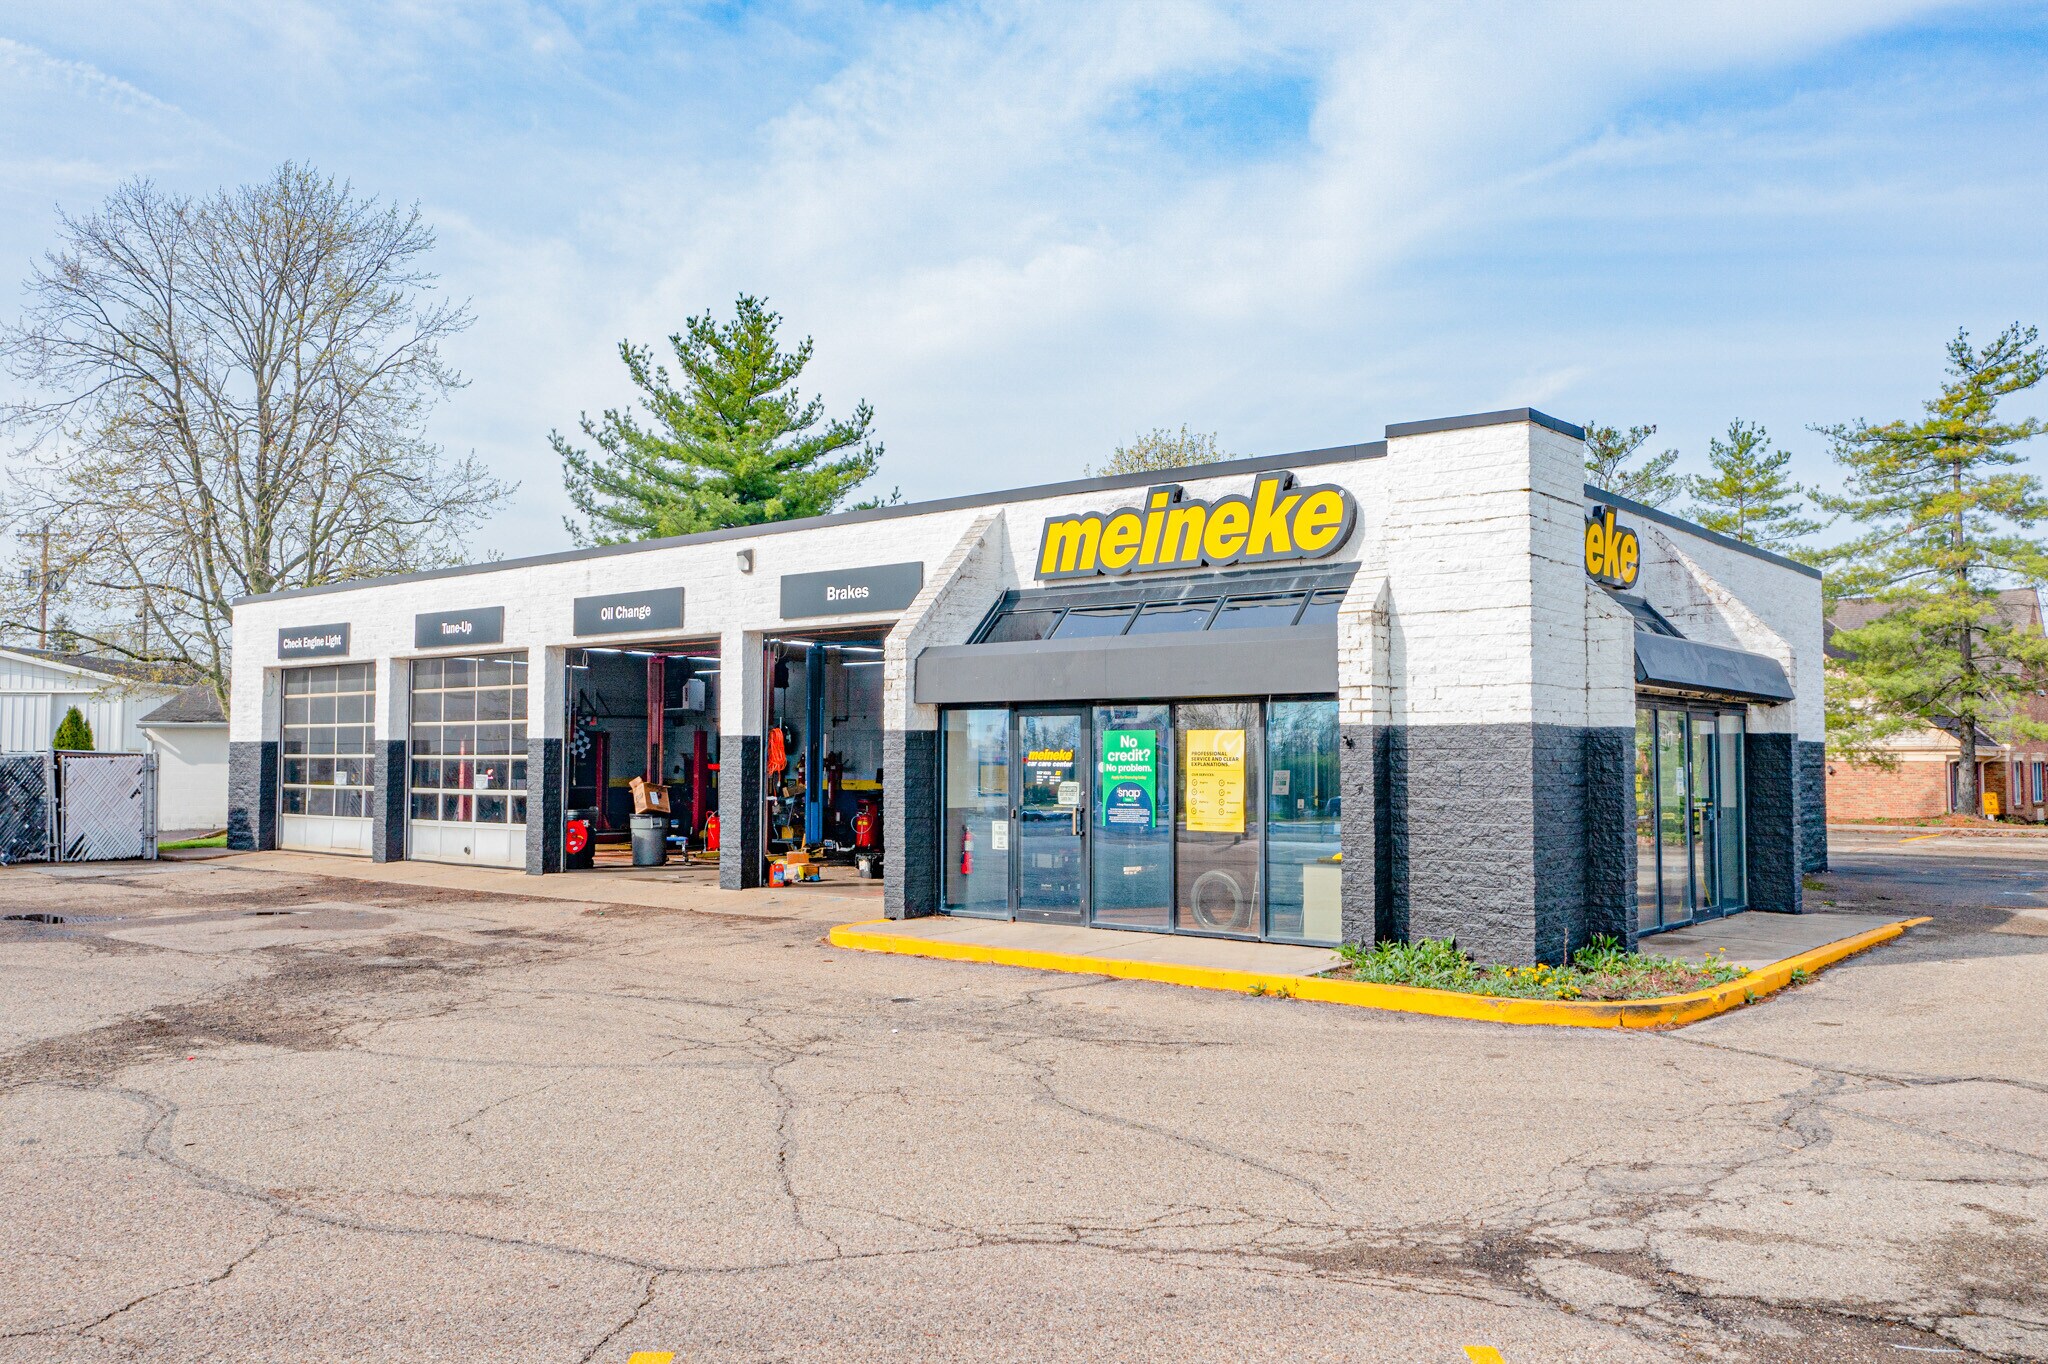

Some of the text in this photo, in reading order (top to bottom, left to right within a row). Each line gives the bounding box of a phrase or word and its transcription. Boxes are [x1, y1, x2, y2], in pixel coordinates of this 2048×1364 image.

[1041, 479, 1344, 574] meineke
[826, 584, 869, 601] Brakes
[601, 605, 651, 620] Oil Change
[441, 620, 473, 635] Tune-Up
[283, 634, 342, 650] Check Engine Light
[1120, 734, 1138, 748] No
[1028, 748, 1073, 761] meineke
[1107, 748, 1151, 762] credit?
[1105, 763, 1152, 774] No problem.
[1117, 789, 1141, 801] snap
